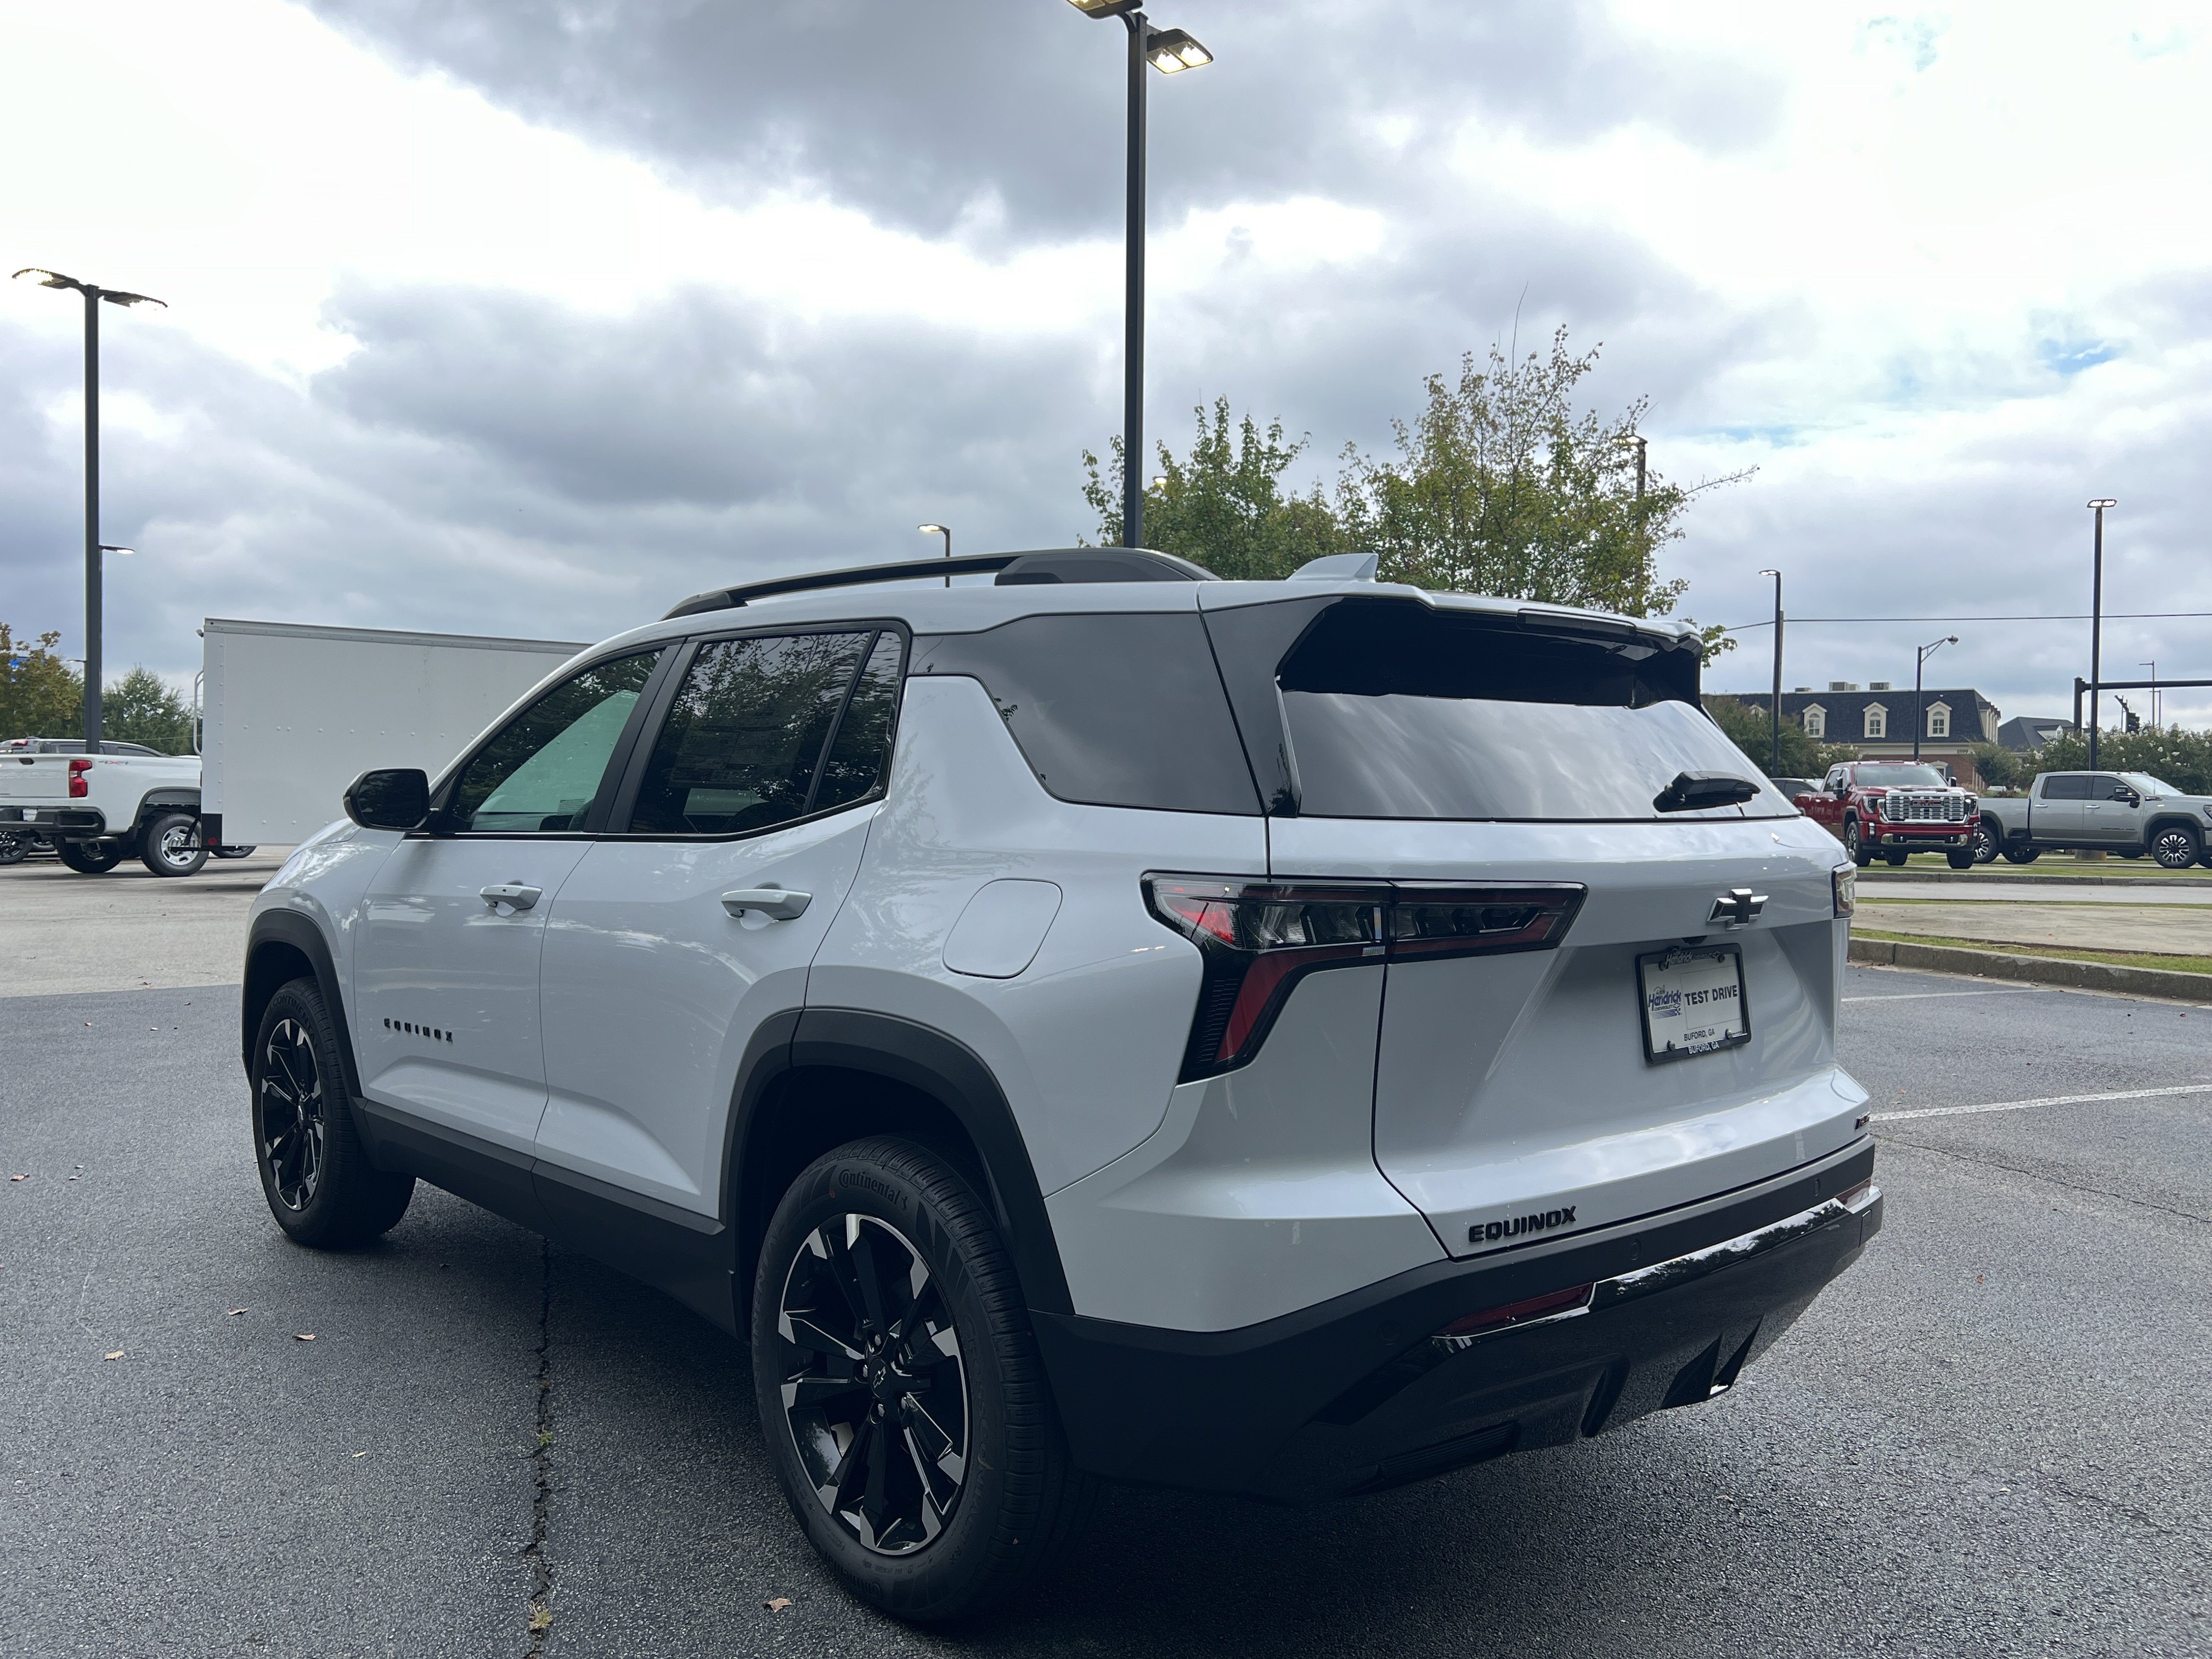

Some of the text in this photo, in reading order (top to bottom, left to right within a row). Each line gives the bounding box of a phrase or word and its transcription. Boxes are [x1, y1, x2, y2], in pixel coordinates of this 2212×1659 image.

[1648, 990, 1681, 1012] Hendrick
[1684, 985, 1738, 1006] TEST DRIVE
[1684, 1028, 1715, 1041] BUFORD, GA
[1688, 1041, 1720, 1054] BUFORD, GA
[838, 1169, 901, 1205] Continental
[1468, 1205, 1577, 1243] EQUINOX
